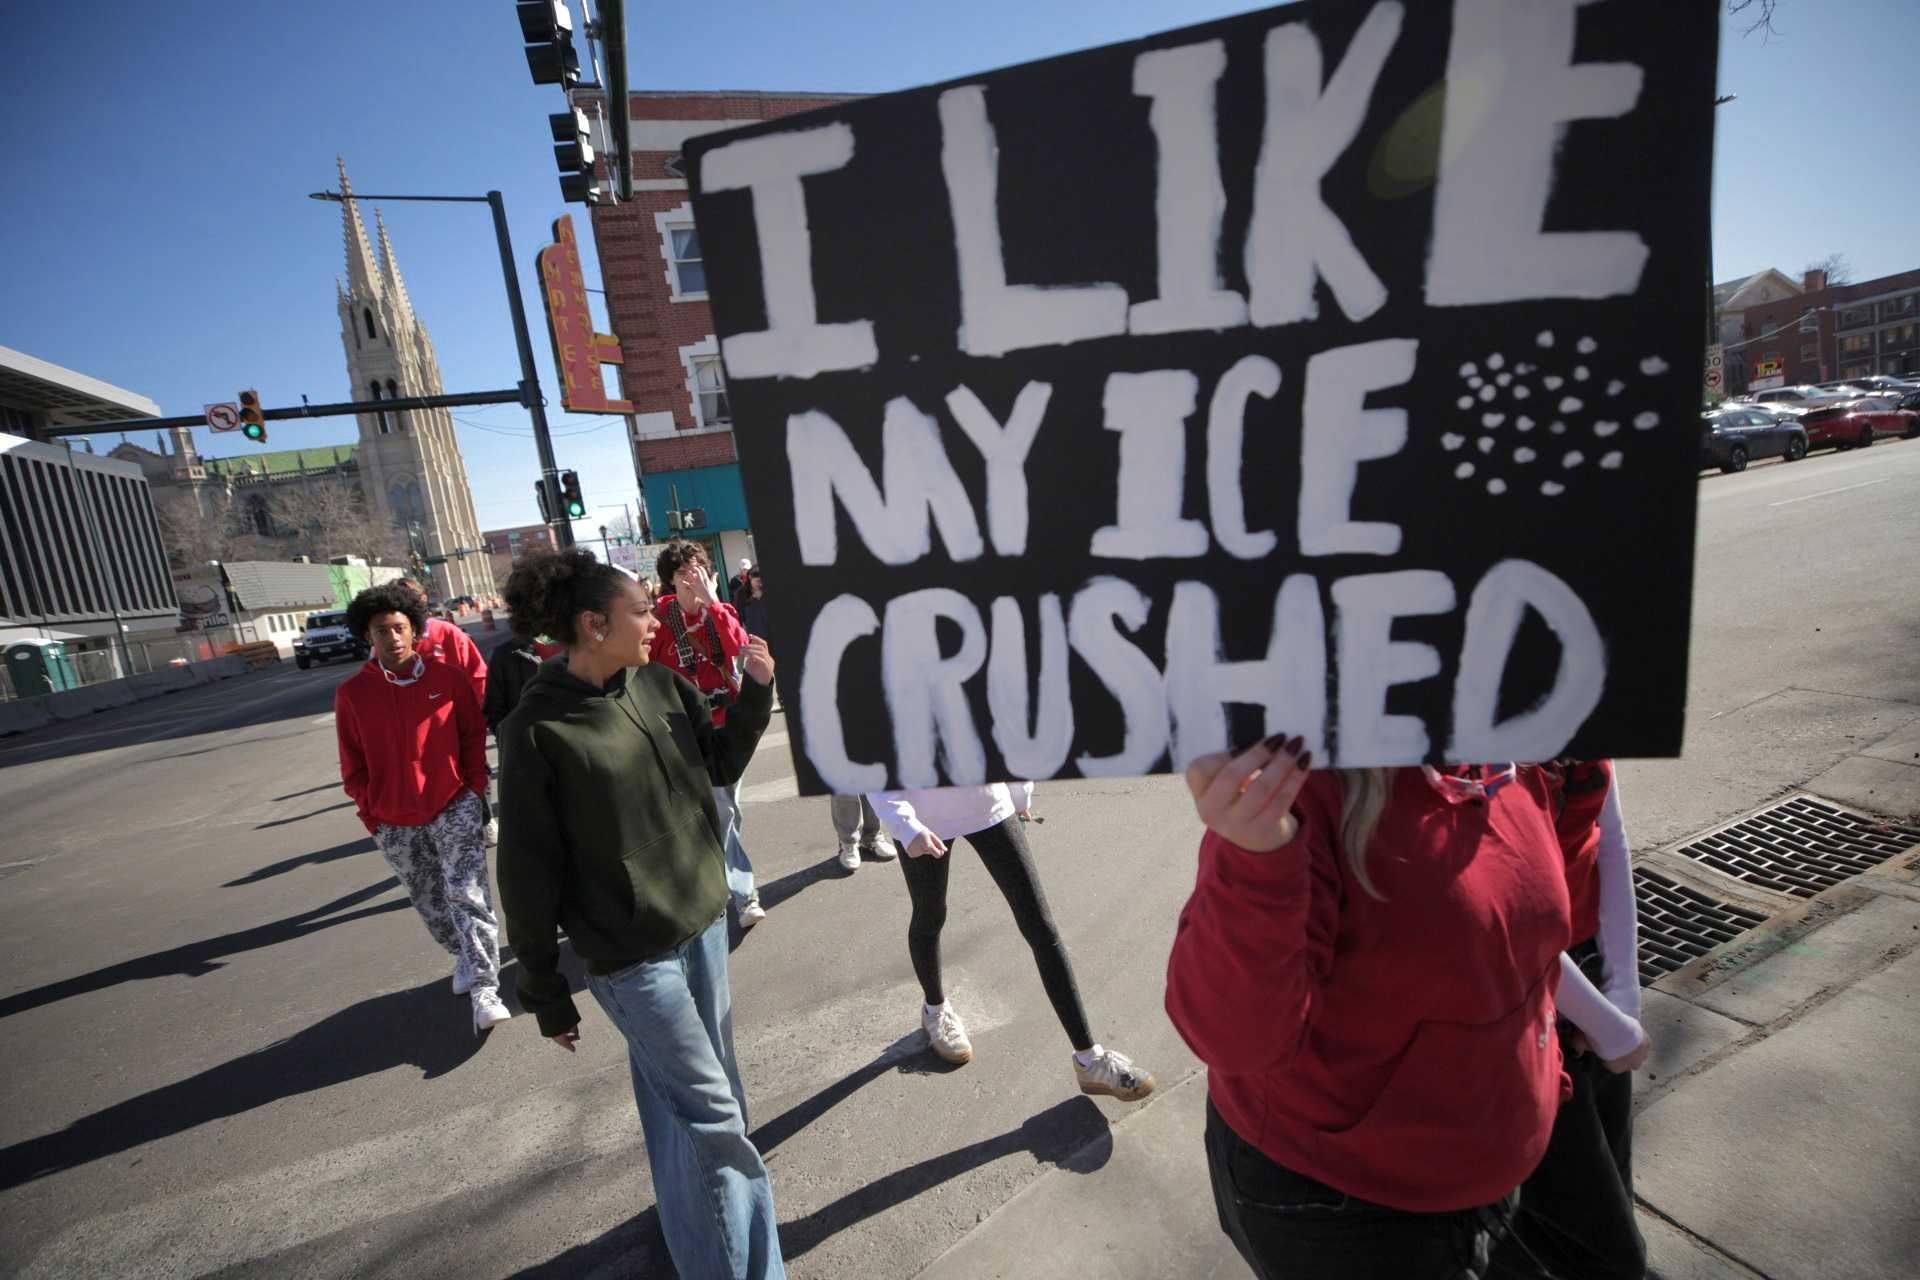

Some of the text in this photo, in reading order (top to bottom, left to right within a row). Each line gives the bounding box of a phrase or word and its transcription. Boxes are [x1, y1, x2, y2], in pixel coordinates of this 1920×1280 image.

[701, 0, 1648, 379] I LIKE
[786, 339, 1418, 565] MY ICE
[801, 559, 1606, 790] CRUSHED
